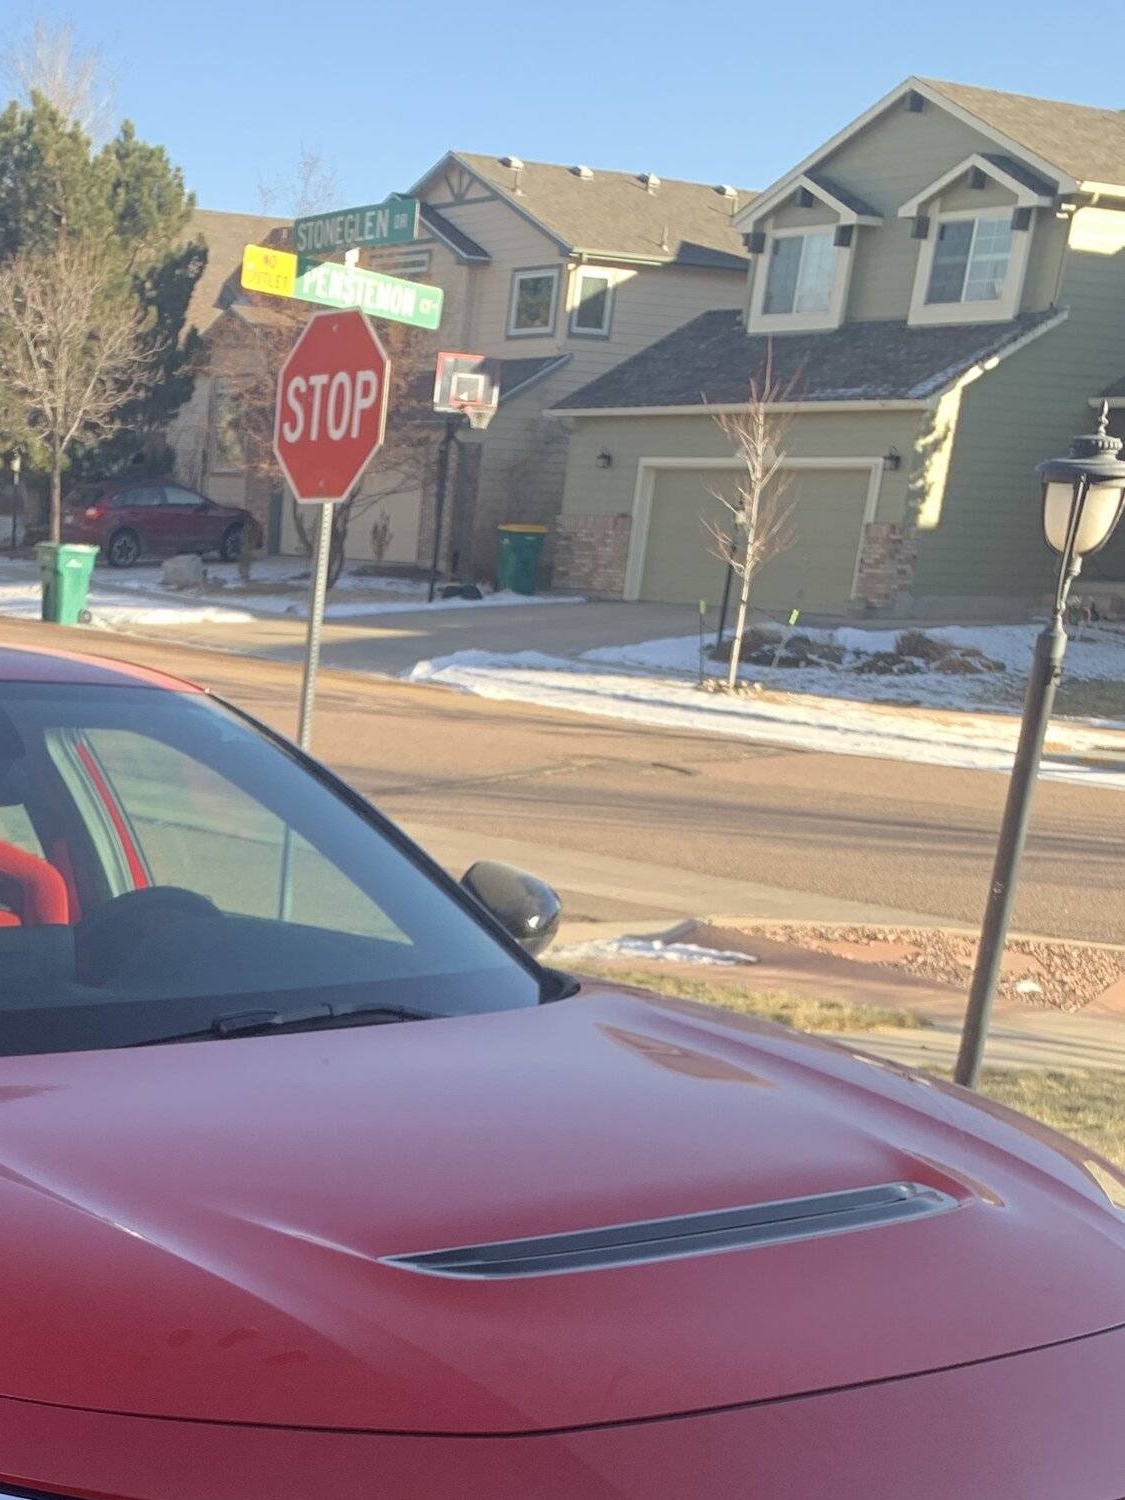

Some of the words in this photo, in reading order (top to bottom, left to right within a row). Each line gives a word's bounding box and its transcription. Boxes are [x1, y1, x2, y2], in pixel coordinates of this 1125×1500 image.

[297, 209, 390, 251] STONEGLEN
[263, 254, 277, 268] NO
[302, 266, 416, 317] PENSTEMON
[282, 369, 378, 443] STOP
